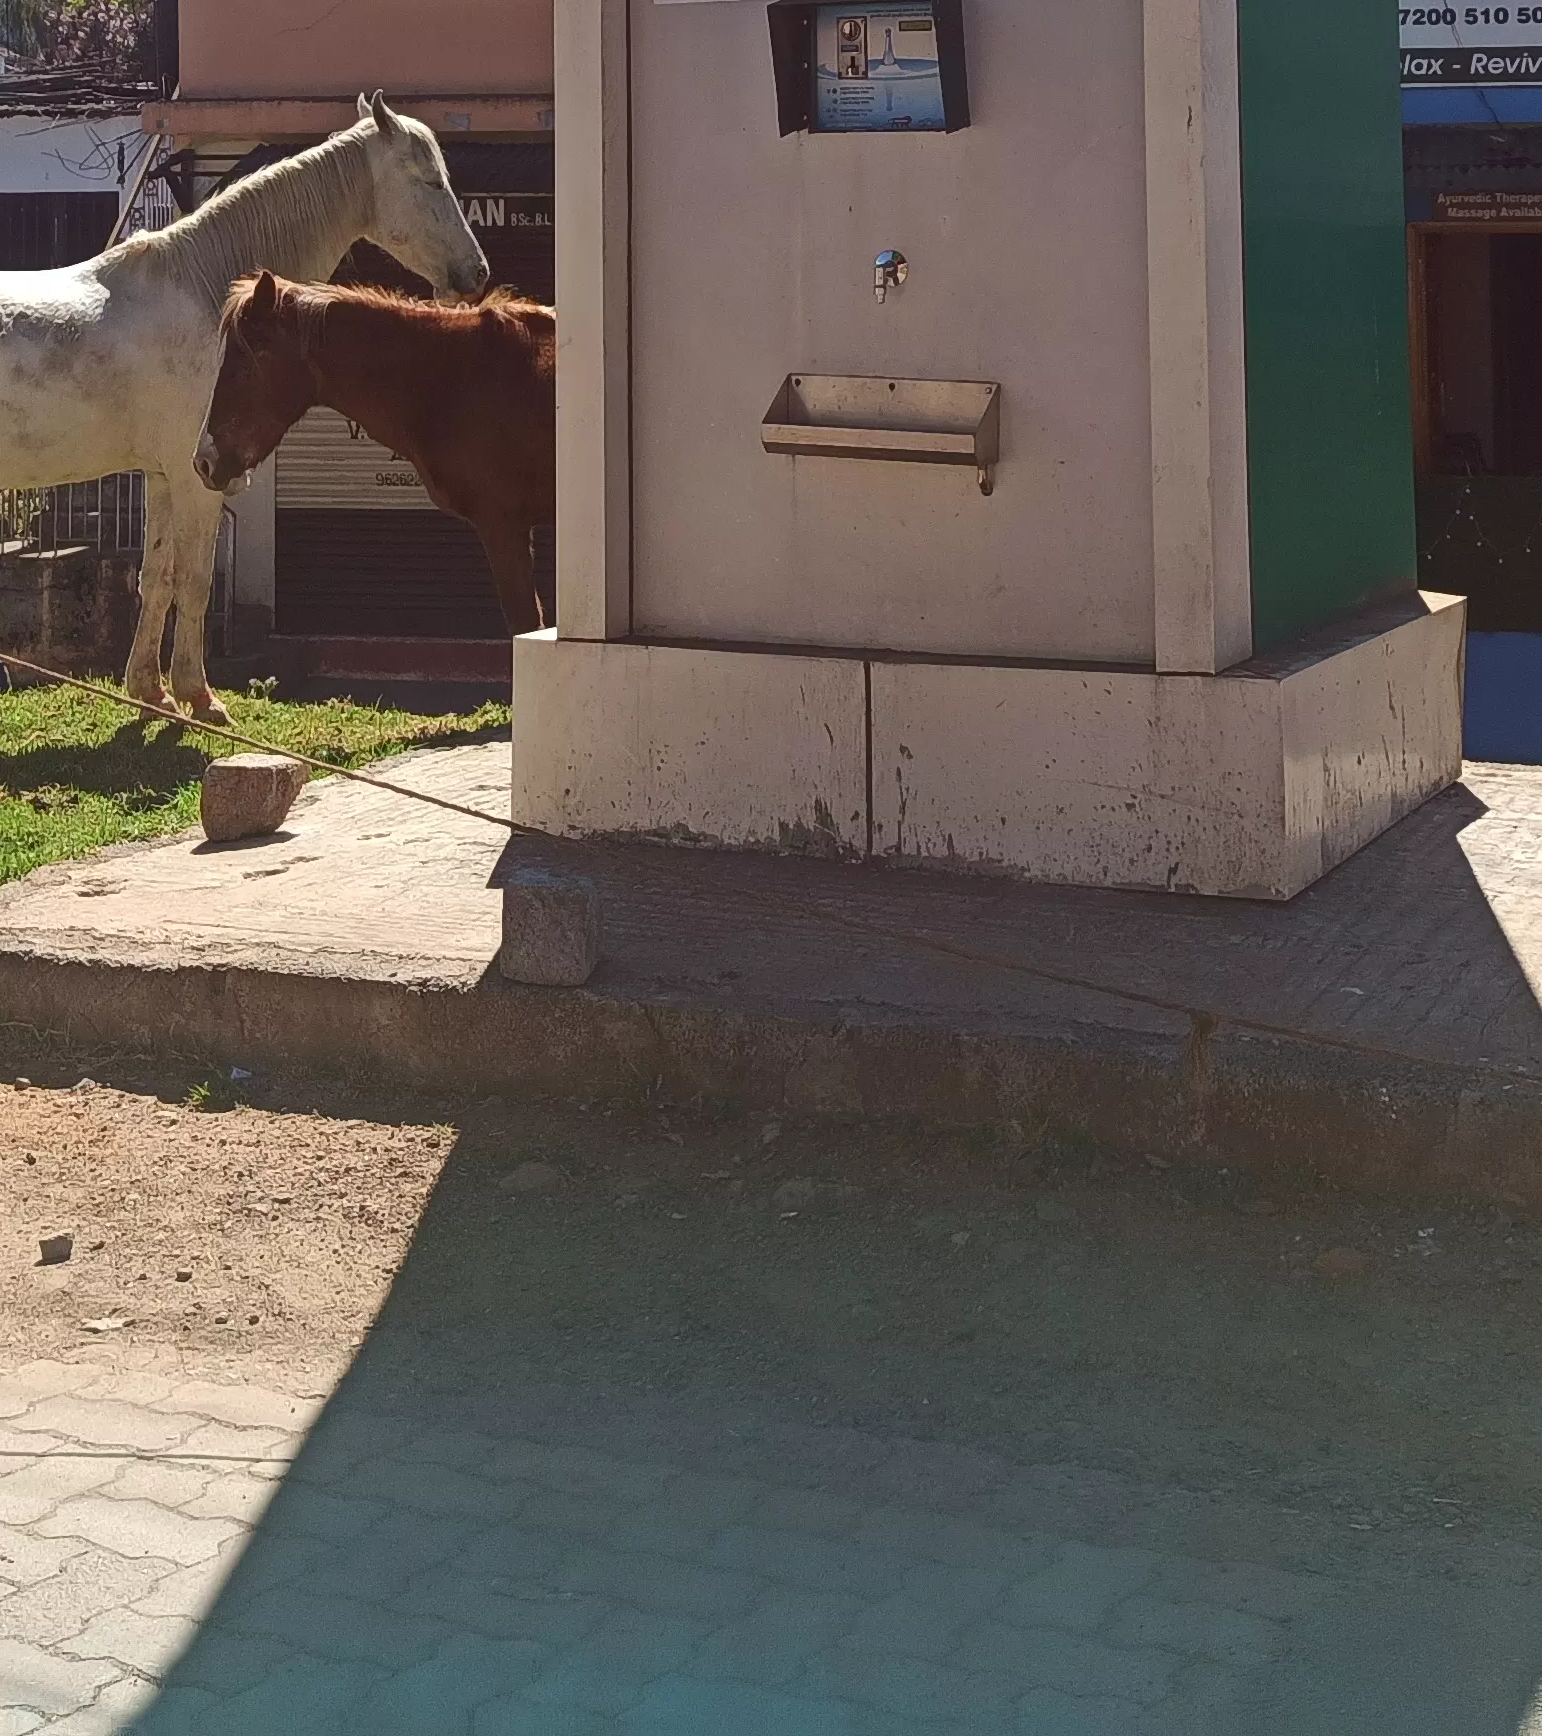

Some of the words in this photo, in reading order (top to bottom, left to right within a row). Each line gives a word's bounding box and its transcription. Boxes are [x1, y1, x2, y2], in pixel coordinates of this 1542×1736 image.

[1464, 7, 1510, 25] 510
[1400, 53, 1445, 76] lax
[1437, 192, 1492, 206] Ayurvedic
[1447, 207, 1497, 220] Massage
